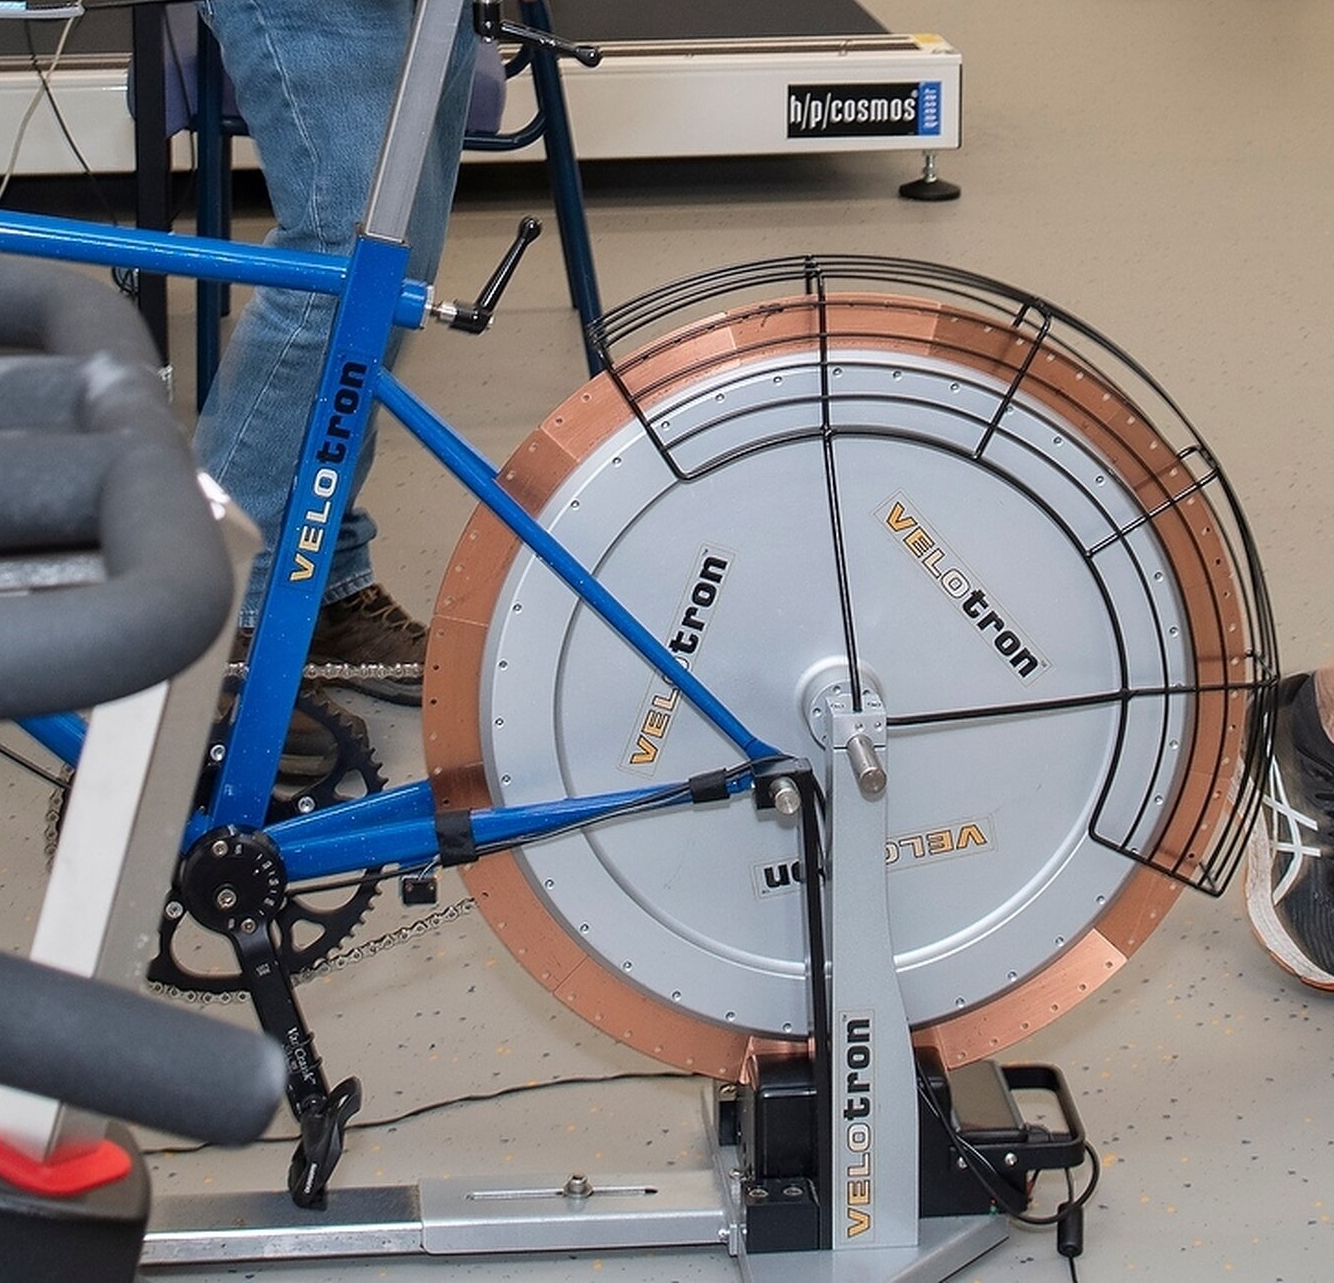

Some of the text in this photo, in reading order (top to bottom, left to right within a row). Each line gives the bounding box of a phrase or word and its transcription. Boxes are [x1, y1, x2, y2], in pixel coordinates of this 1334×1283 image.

[290, 361, 367, 582] VELOtron
[886, 501, 1039, 678] VELOtron
[843, 1018, 871, 1239] VELOtron
